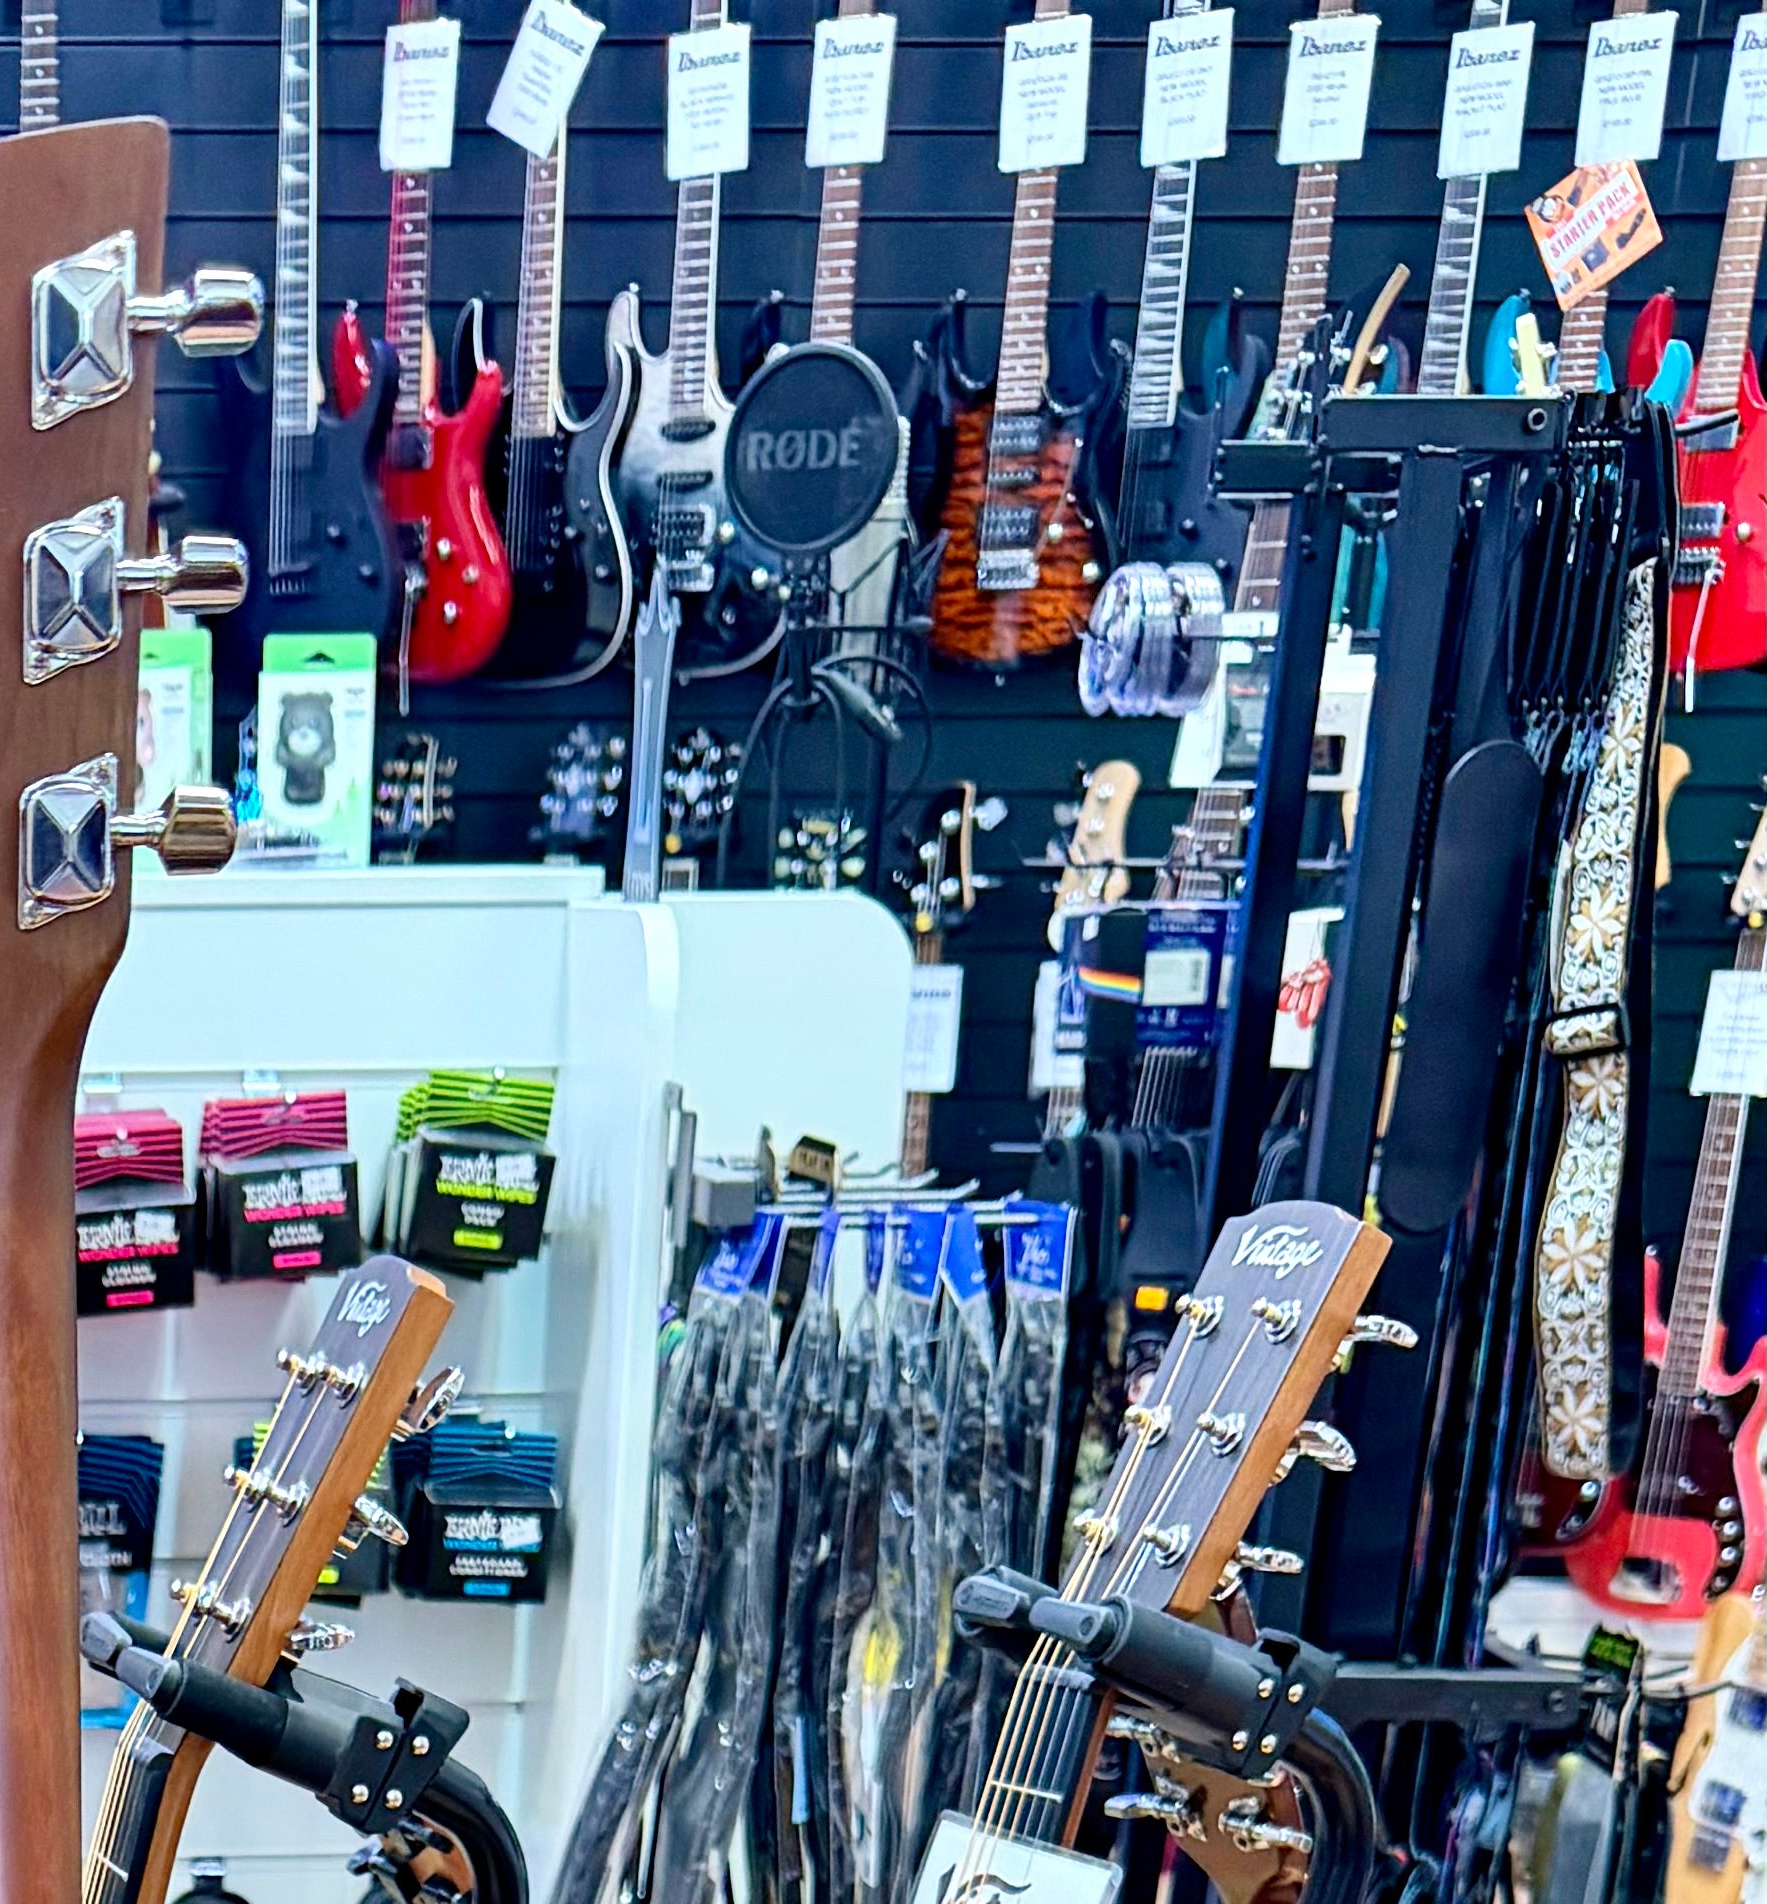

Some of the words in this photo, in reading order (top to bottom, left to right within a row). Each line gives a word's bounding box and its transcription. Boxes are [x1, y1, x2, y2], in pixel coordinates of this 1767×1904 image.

[1010, 40, 1080, 62] Ibanez
[1153, 35, 1222, 57] Ibanez
[1298, 36, 1368, 58] Ibanez
[1593, 36, 1664, 58] Ibanez
[1454, 47, 1523, 69] Ibanez
[1231, 1224, 1324, 1280] Vintage
